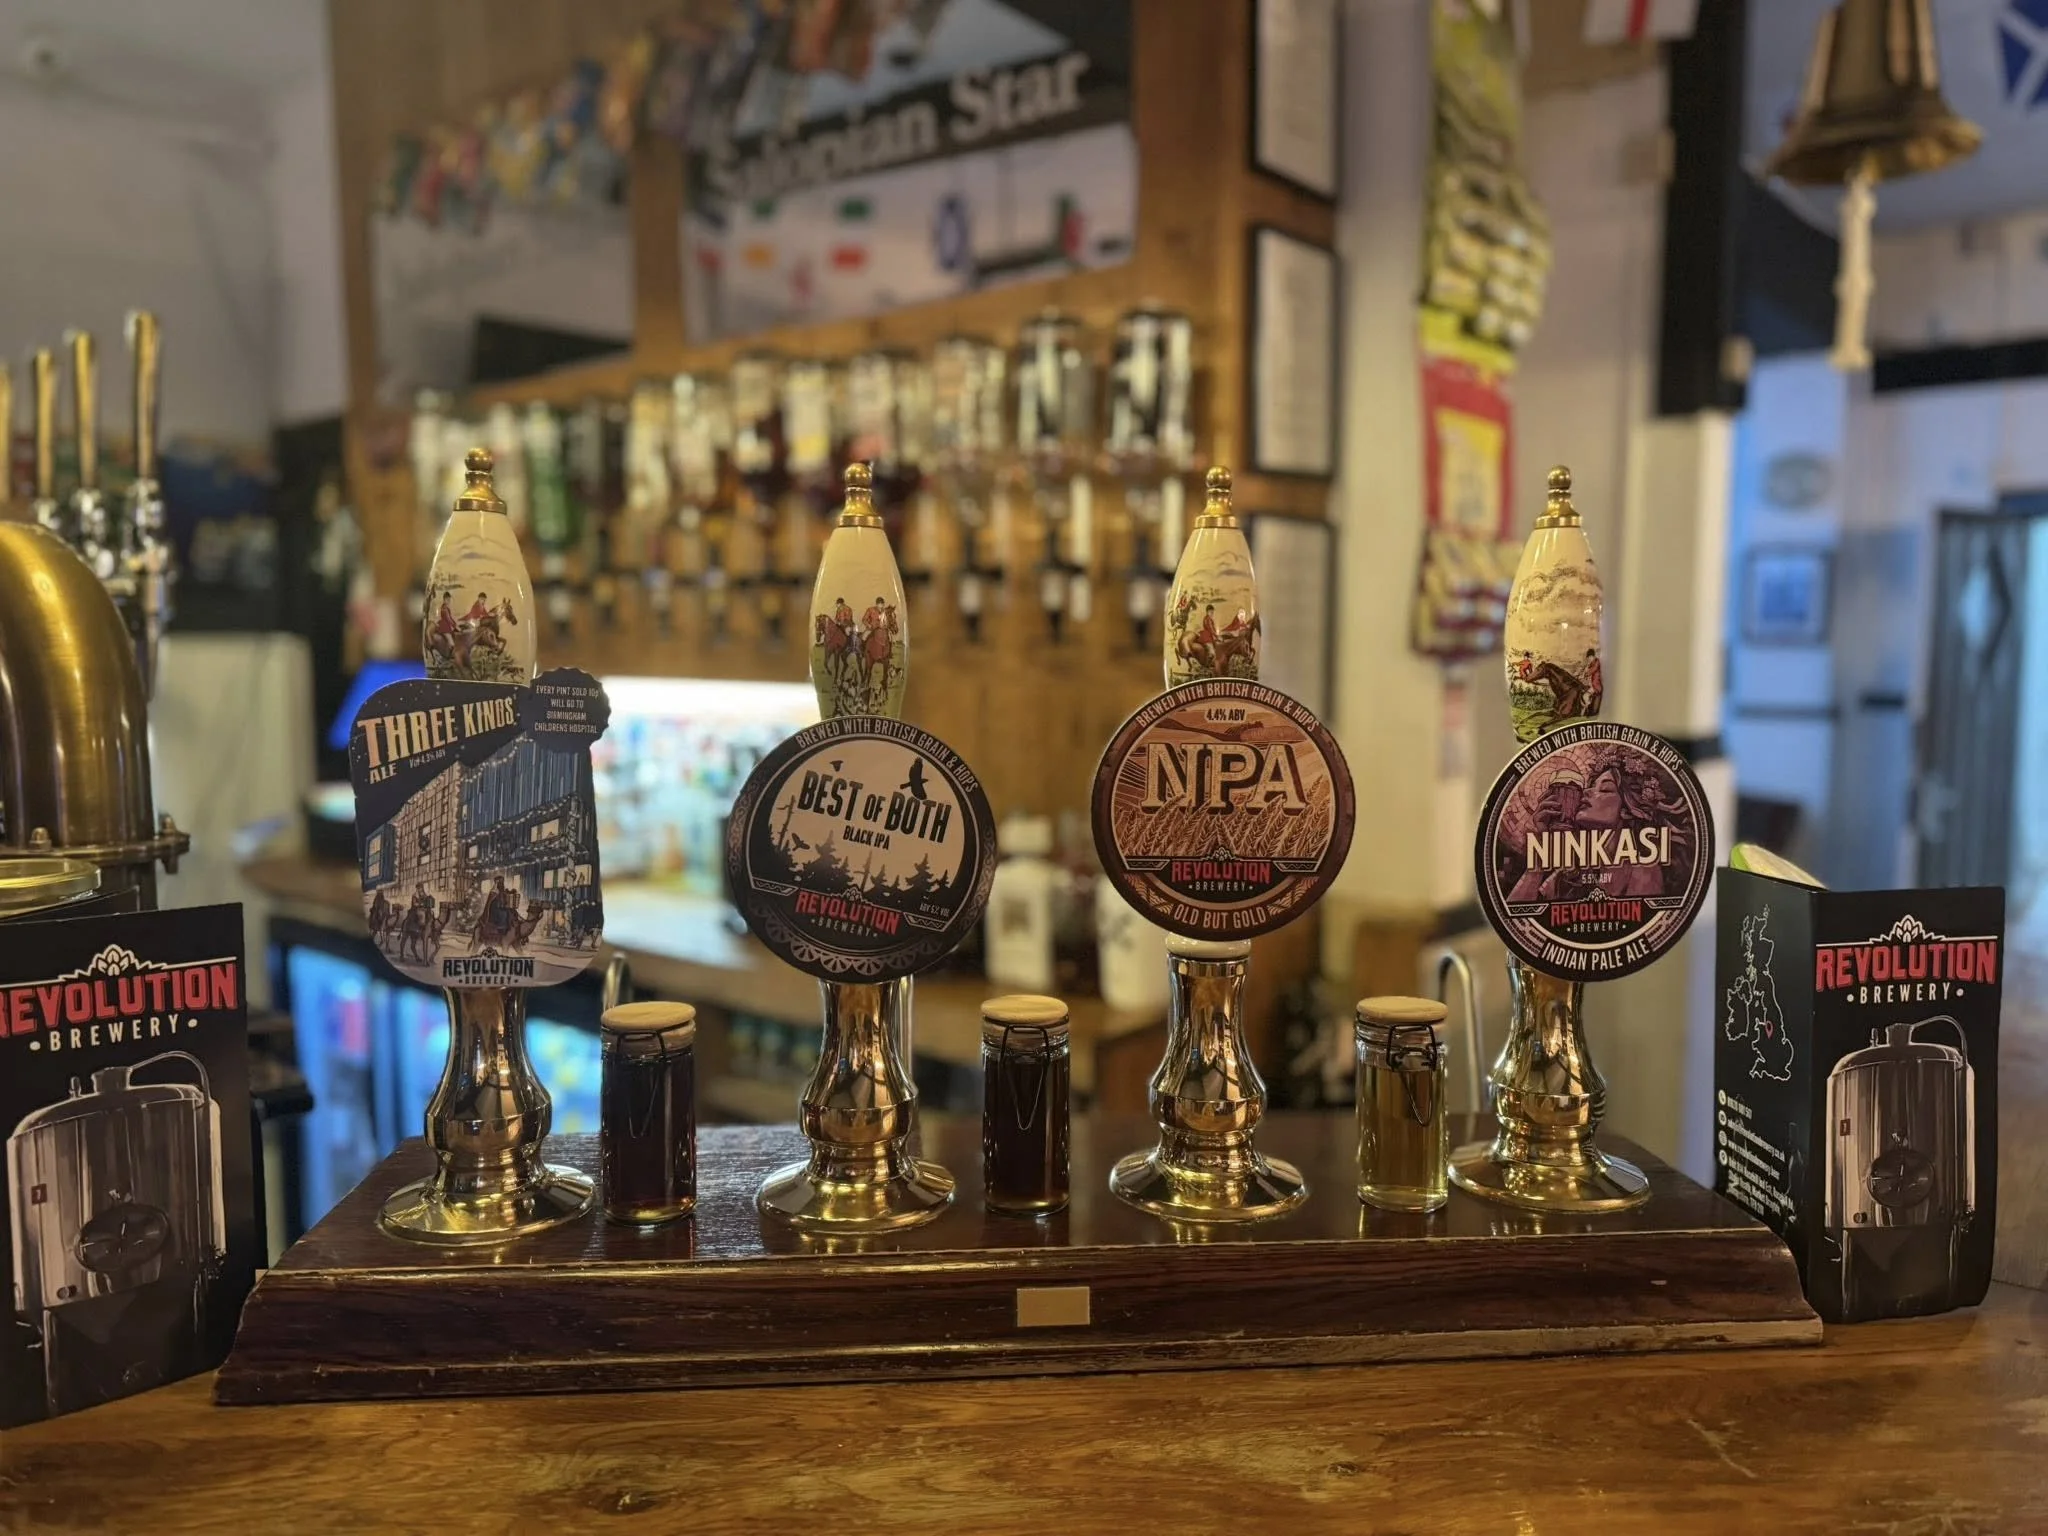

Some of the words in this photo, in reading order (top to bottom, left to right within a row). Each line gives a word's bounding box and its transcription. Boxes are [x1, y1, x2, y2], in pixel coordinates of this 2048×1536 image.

[948, 53, 1092, 143] Star
[536, 685, 555, 695] EVERY
[556, 686, 570, 696] PINT
[572, 687, 587, 697] SOLD
[546, 710, 587, 721] BIRMINGHAM
[551, 699, 565, 708] WILL
[566, 699, 575, 708] GO
[576, 699, 584, 709] TO
[1135, 695, 1176, 728] BREWED
[1176, 685, 1203, 706] WITH
[1207, 682, 1249, 697] BRITISH
[1251, 686, 1285, 709] GRAIN
[1283, 701, 1294, 713] &
[1294, 705, 1320, 732] HOPS
[1206, 708, 1226, 721] 4.4%
[1228, 708, 1246, 721] ABV
[357, 706, 458, 768] THREE
[534, 722, 568, 733] CHILDRENS
[569, 724, 598, 734] HOSPITAL
[795, 721, 840, 748] BREWED
[842, 718, 871, 734] WITH
[874, 720, 918, 742] BRITISH
[917, 734, 949, 761] GRAIN
[946, 755, 956, 767] &
[953, 764, 978, 793] HOPS
[1514, 741, 1551, 774] BREWED
[1552, 728, 1578, 749] WITH
[1579, 724, 1618, 740] BRITISH
[1620, 727, 1652, 749] GRAIN
[1650, 740, 1659, 753] &
[1657, 746, 1683, 771] HOPS
[370, 763, 397, 784] ALE
[1140, 742, 1310, 816] NPA
[797, 770, 863, 821] BEST
[863, 794, 886, 822] OF
[884, 791, 952, 843] BOTH
[843, 825, 874, 845] BLACK
[874, 832, 890, 850] IPA
[1526, 826, 1671, 871] NINKASI
[1171, 861, 1272, 885] REVOLUTION
[1599, 872, 1612, 884] ABV
[1196, 881, 1246, 892] BREWERY
[795, 891, 900, 935] REVOLUTION
[1174, 904, 1199, 926] OLD
[1203, 911, 1229, 929] BUT
[1233, 907, 1266, 929] GOLD
[1551, 901, 1642, 927] REVOLUTION
[817, 916, 871, 937] BREWERY
[1573, 922, 1620, 933] BREWERY
[1541, 942, 1587, 970] INDIAN
[1591, 948, 1623, 971] PALE
[1626, 938, 1649, 964] ALE
[1815, 941, 1998, 993] REVOLUTION
[443, 960, 534, 978] REVOLUTION
[465, 976, 512, 985] BREWERY
[1860, 982, 1951, 1004] BREWERY
[50, 1013, 179, 1052] BREWERY
